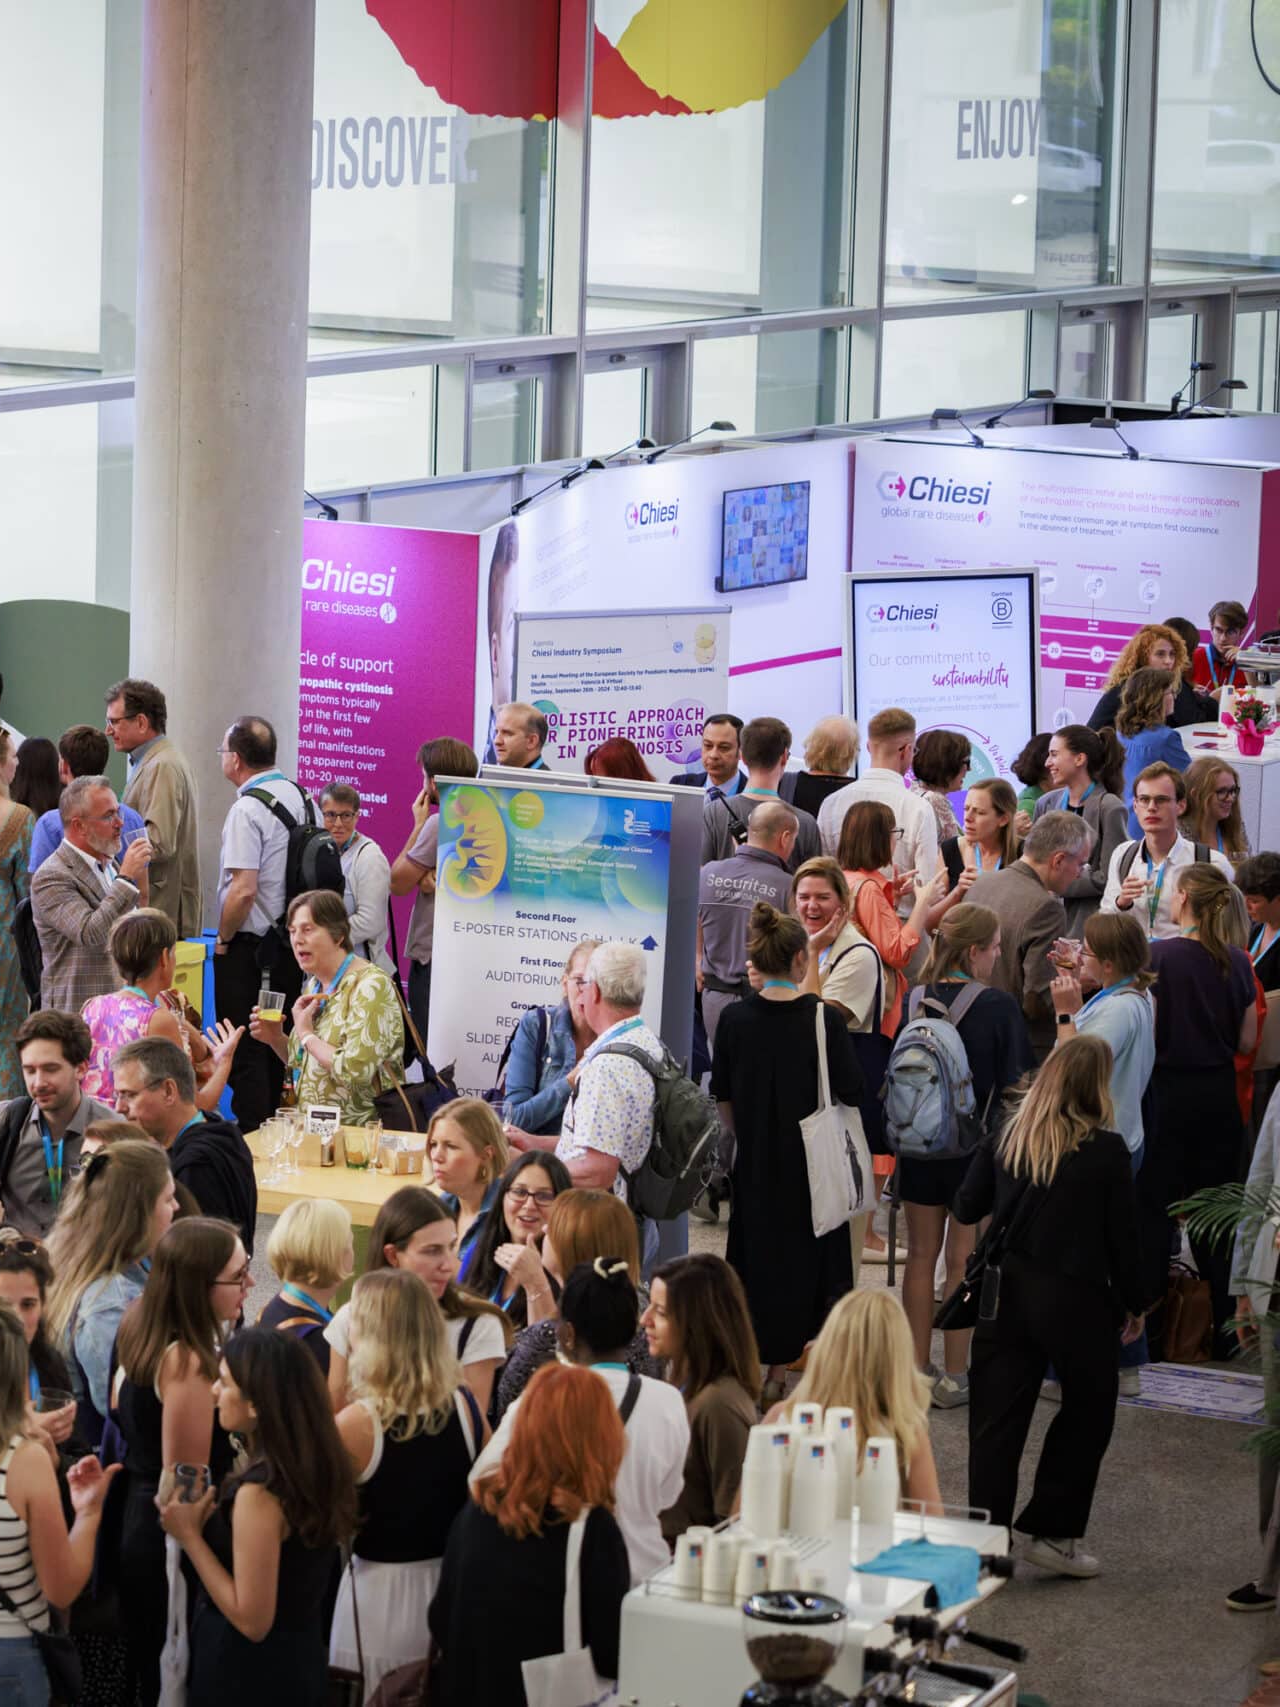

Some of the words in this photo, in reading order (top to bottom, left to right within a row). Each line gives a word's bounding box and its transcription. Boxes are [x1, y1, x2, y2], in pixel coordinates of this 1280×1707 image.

[909, 476, 992, 505] Chiesi
[640, 498, 679, 525] Chiesi
[881, 506, 910, 519] global
[302, 559, 396, 597] Chiesi
[304, 600, 329, 613] rare
[332, 601, 378, 617] diseases
[887, 604, 939, 621] Chiesi
[531, 649, 552, 657] Chiesi
[553, 647, 581, 656] Industry
[582, 646, 622, 656] Symposium
[869, 653, 891, 667] Our
[895, 650, 974, 667] commitment
[977, 651, 991, 663] to
[321, 652, 336, 668] of
[339, 656, 394, 674] support
[932, 661, 1009, 688] sustainability
[344, 682, 394, 695] cystinosis
[341, 696, 380, 711] typically
[305, 708, 313, 718] in
[316, 708, 331, 720] the
[333, 710, 352, 722] first
[354, 712, 371, 724] few
[627, 708, 704, 723] APPROACH
[302, 723, 312, 733] of
[332, 726, 352, 738] with
[674, 720, 705, 738] CAR
[318, 741, 385, 757] manifestations
[557, 745, 576, 759] IN
[312, 756, 354, 769] apparent
[356, 761, 377, 771] over
[706, 873, 777, 897] Securitas
[515, 910, 550, 922] Second
[552, 911, 577, 924] Floor
[453, 921, 514, 938] E-POSTER
[518, 927, 578, 944] STATIONS
[520, 956, 540, 966] First
[466, 1032, 501, 1045] SLIDE
